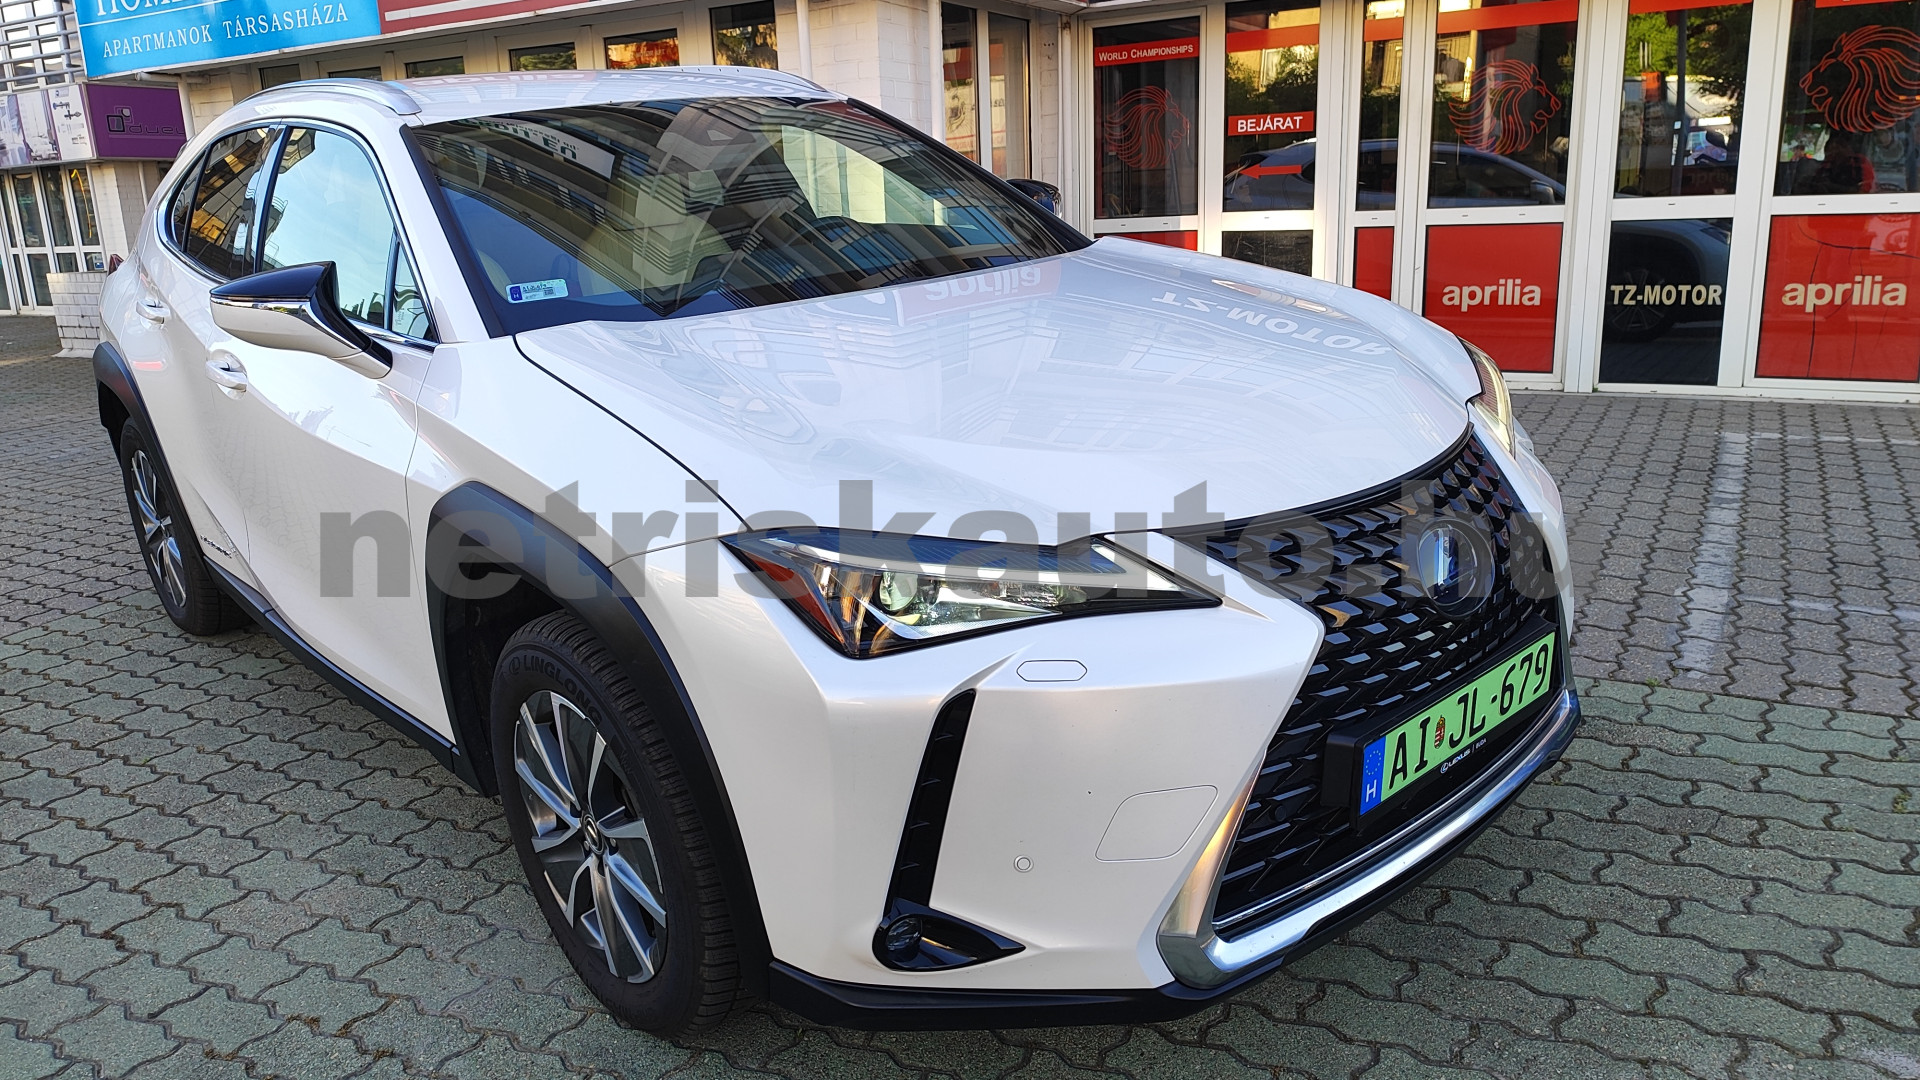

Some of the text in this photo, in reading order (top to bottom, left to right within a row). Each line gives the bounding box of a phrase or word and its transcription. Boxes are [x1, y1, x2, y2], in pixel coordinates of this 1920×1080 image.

[103, 24, 213, 58] APARTMANOK
[222, 2, 349, 39] TÁRSASHÁZA
[1237, 115, 1304, 133] BEJÁRAT
[1442, 278, 1542, 312] aprilia
[1610, 284, 1723, 306] TZ-MOTOR
[1781, 275, 1908, 313] aprilia
[523, 655, 603, 724] LINGLONG
[1388, 643, 1550, 790] AI JL-679
[1365, 779, 1378, 803] H
